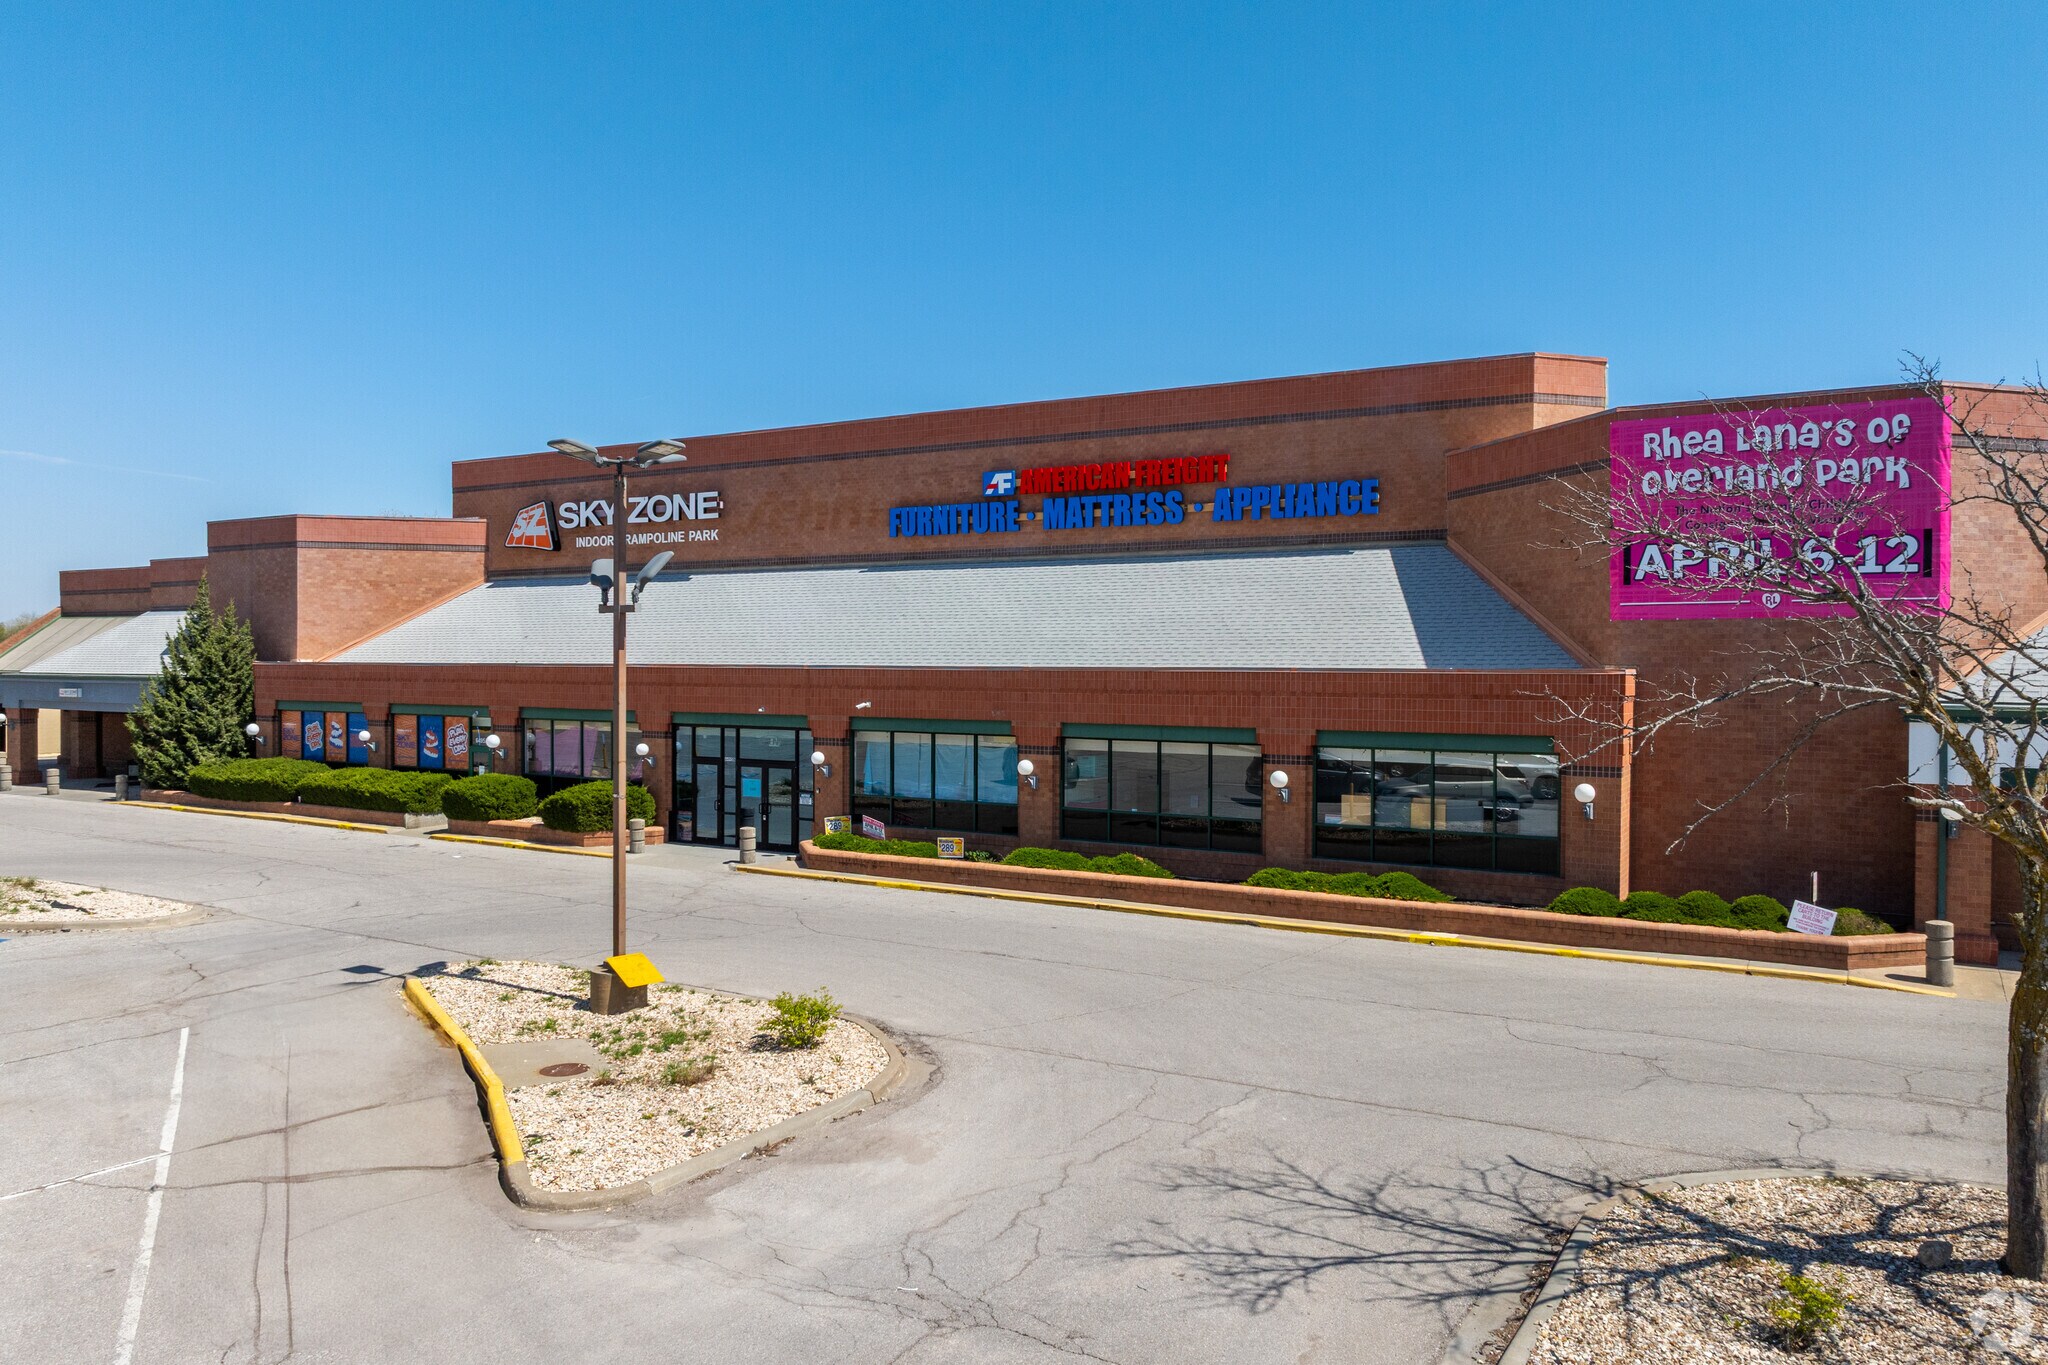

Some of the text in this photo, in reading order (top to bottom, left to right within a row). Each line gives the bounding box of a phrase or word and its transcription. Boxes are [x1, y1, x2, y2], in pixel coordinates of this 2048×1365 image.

[1643, 427, 1723, 461] Rhea
[1020, 454, 1230, 495] AMERICAN FREIGHT
[558, 491, 719, 529] SKY ZONE
[889, 478, 1379, 538] FURNITURE MATTRESS APPLIANCE
[576, 529, 719, 548] INDOOR RAMPOLINE PARK
[1634, 534, 1919, 580] APRIL 6-12
[1765, 595, 1778, 605] RL
[449, 724, 464, 737] PLAY
[449, 734, 466, 745] EVERY
